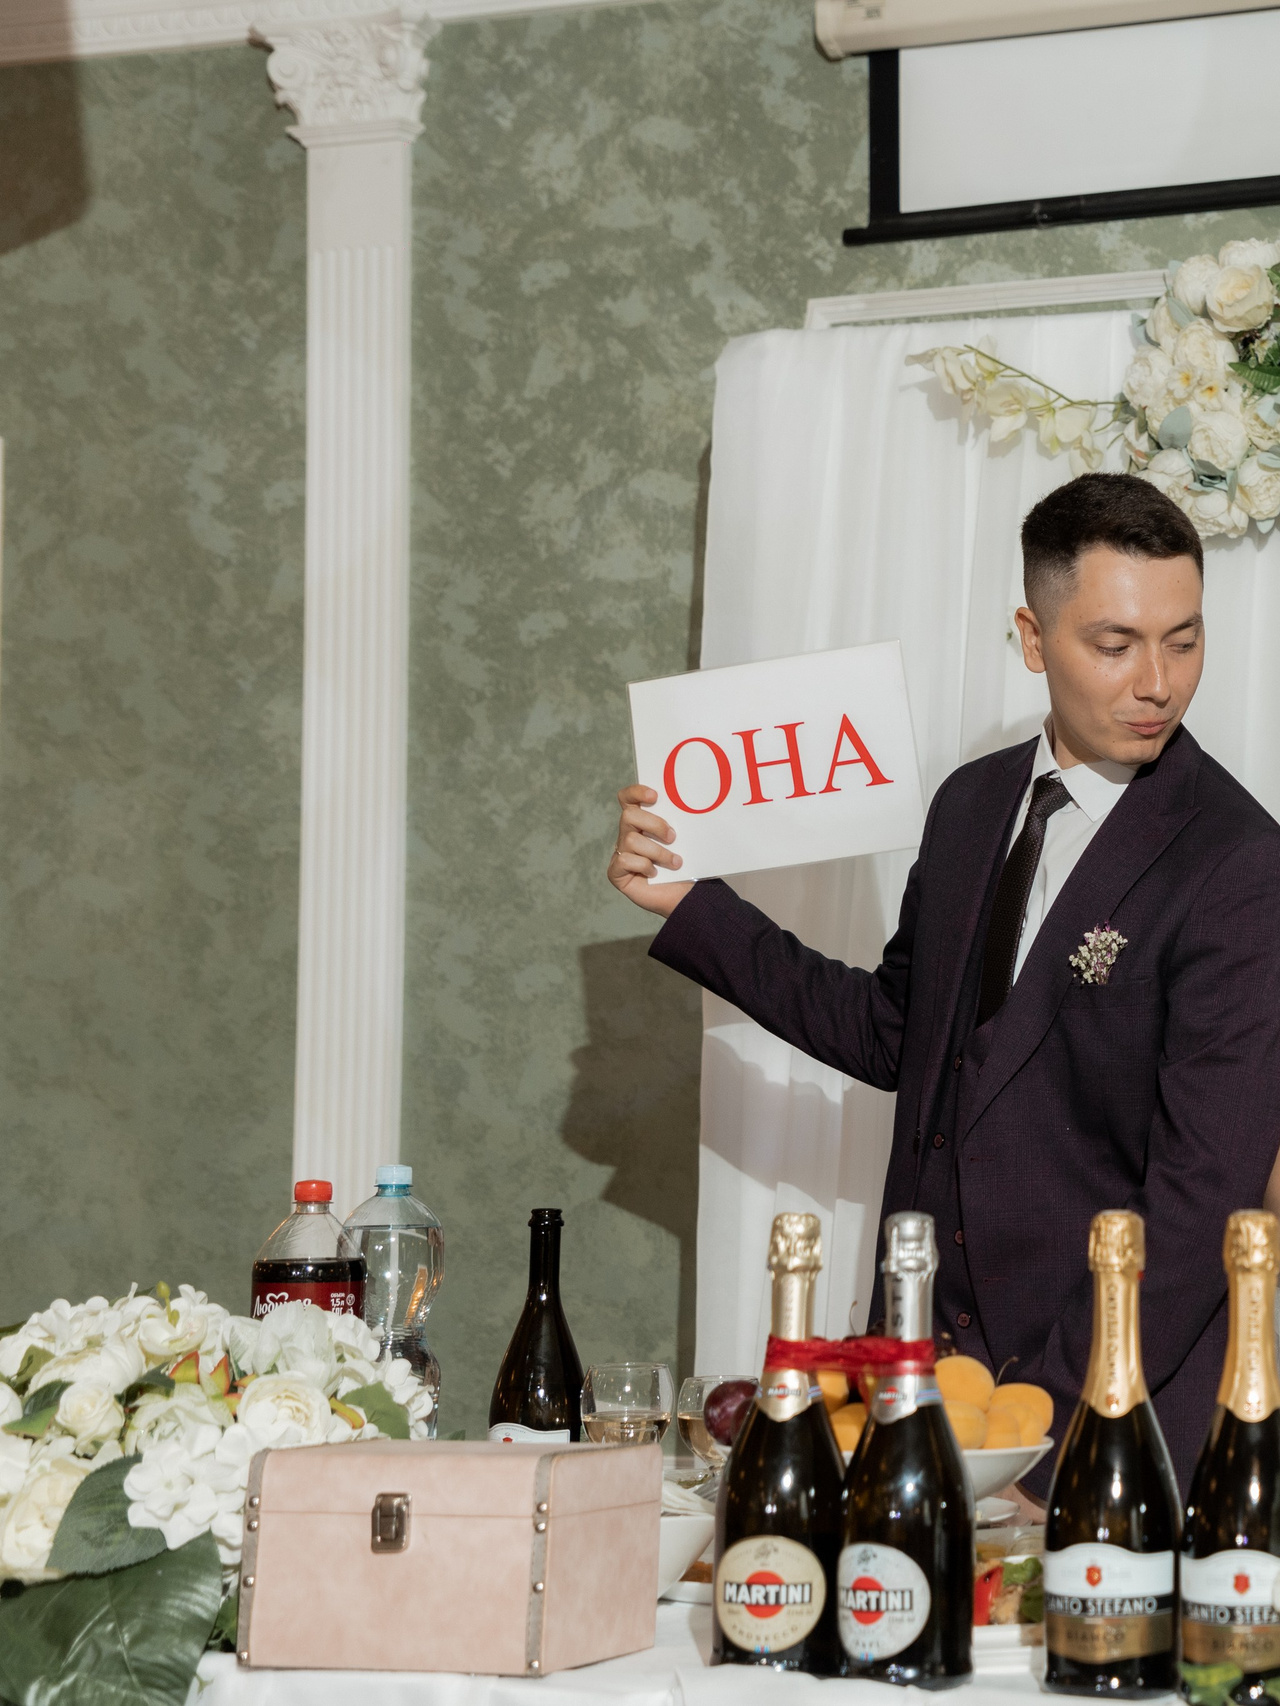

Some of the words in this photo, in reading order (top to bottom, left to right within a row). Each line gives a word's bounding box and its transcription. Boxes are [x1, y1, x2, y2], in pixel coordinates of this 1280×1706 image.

[663, 714, 894, 814] ОНА
[252, 1292, 312, 1318] Любия
[724, 1583, 810, 1605] MARTINI
[839, 1588, 911, 1612] MARTINI
[1087, 1596, 1158, 1616] STEFANO
